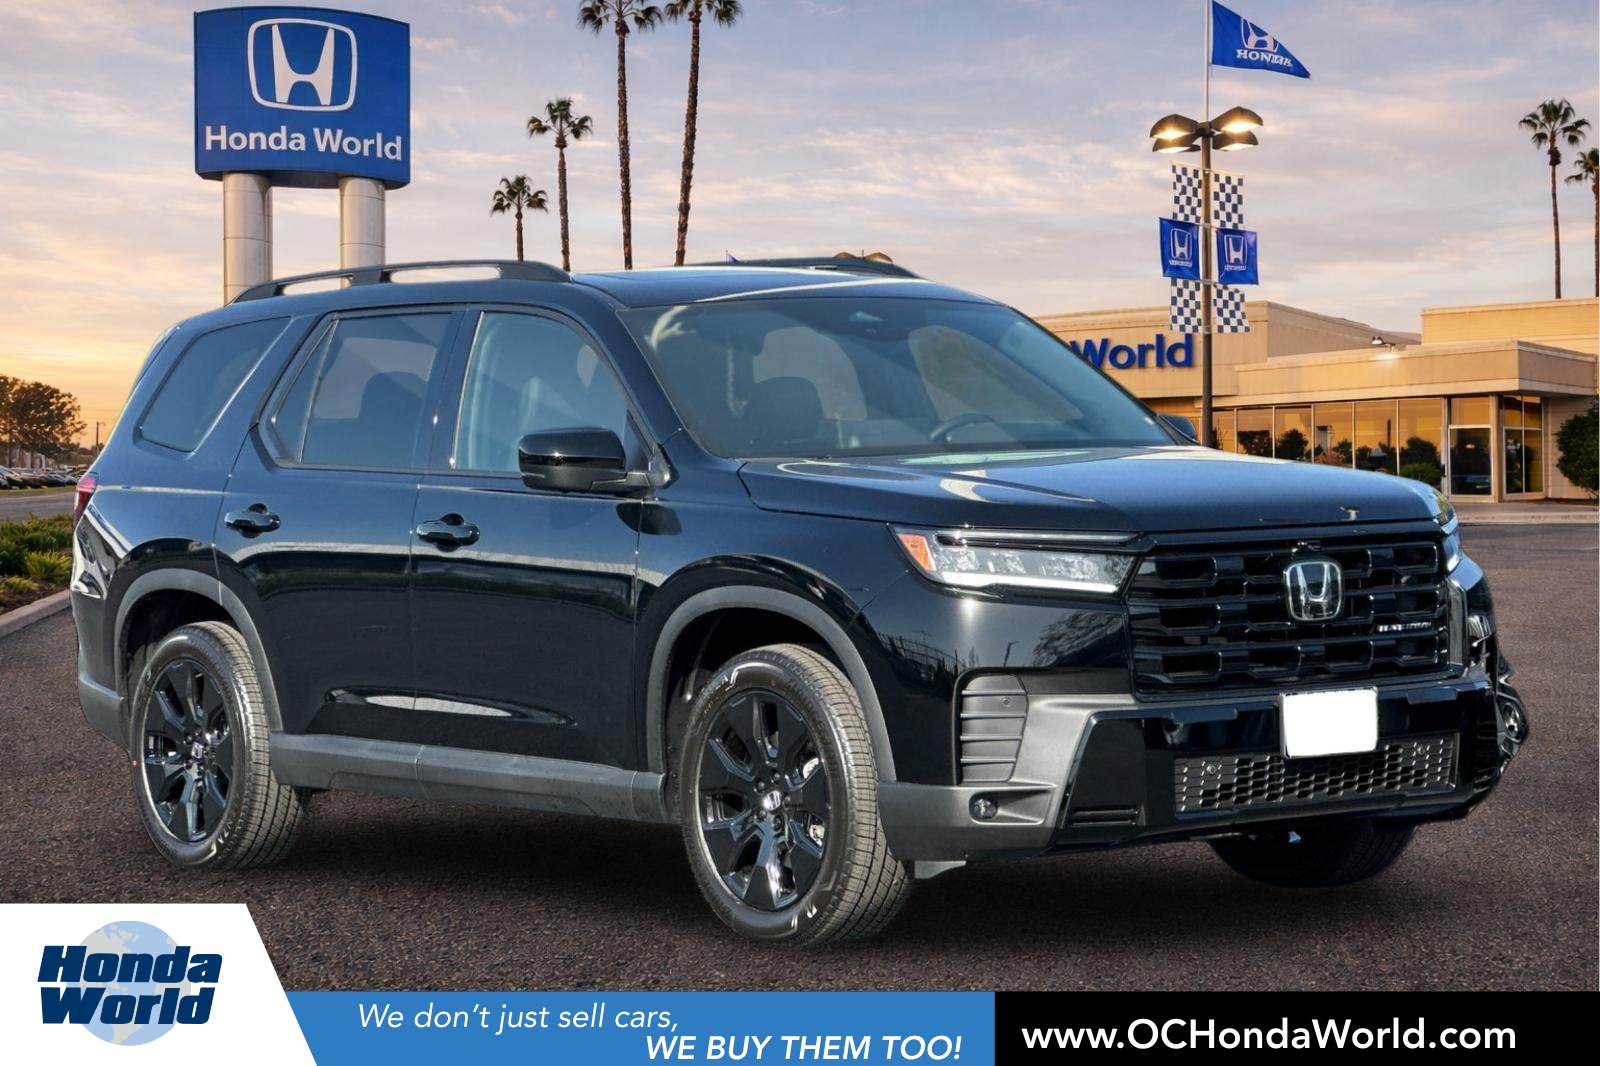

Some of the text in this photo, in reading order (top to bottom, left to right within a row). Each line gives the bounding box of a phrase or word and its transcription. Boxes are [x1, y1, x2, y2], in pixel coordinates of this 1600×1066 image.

[205, 125, 402, 160] Honda World
[1069, 333, 1194, 370] World
